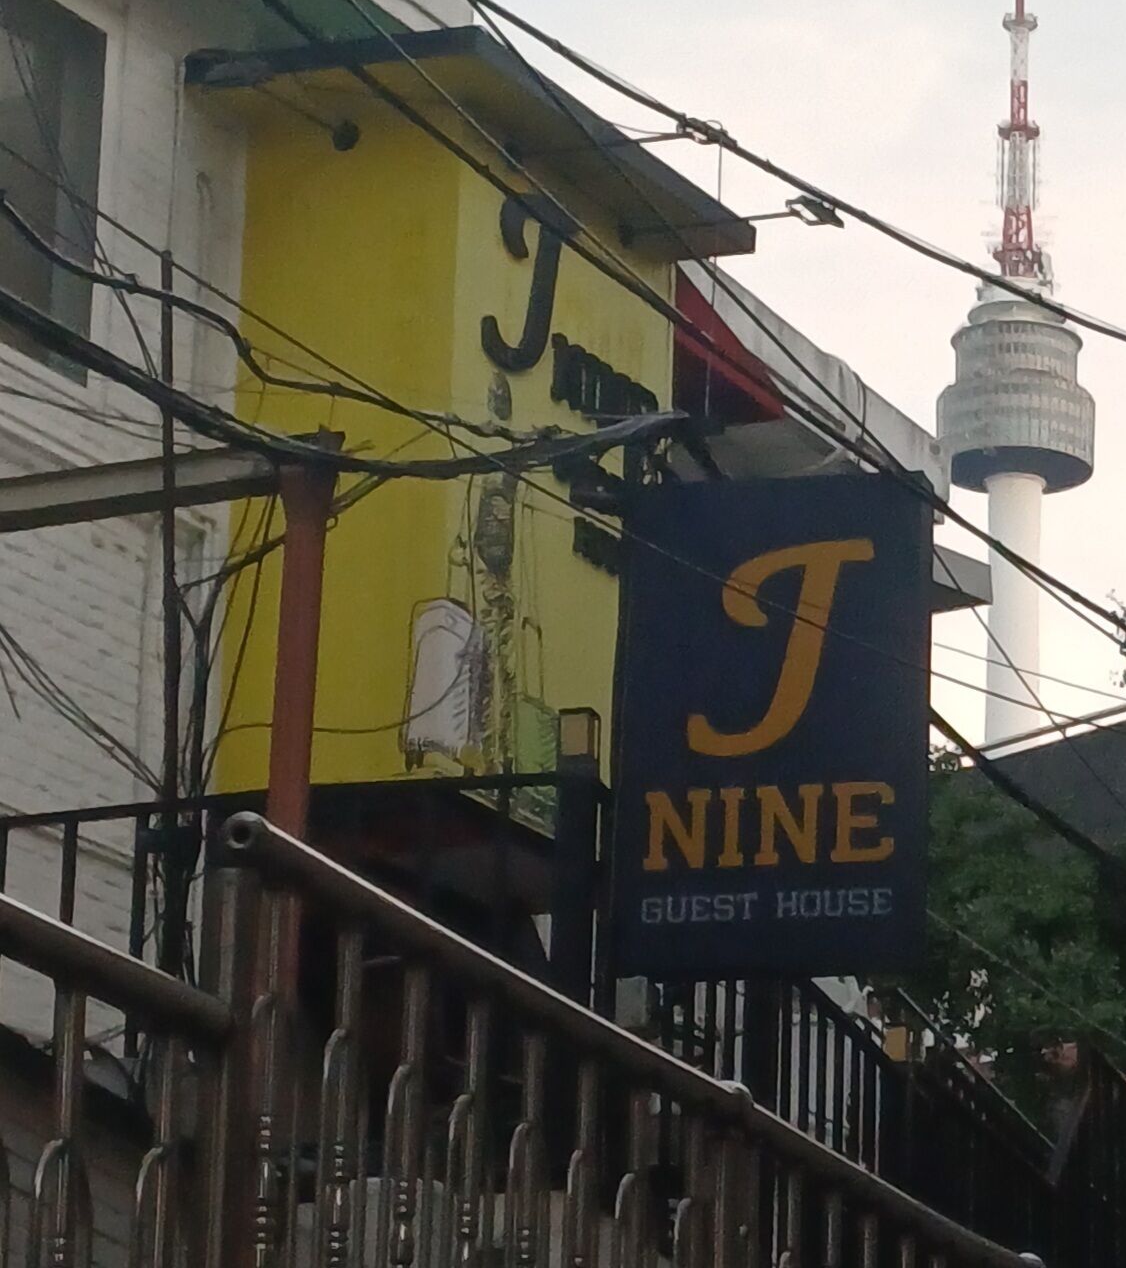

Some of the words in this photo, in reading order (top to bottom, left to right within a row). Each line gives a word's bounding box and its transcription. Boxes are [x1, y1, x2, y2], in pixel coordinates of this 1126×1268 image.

[686, 538, 875, 757] J
[642, 780, 895, 872] NINE
[640, 891, 758, 925] GUEST
[774, 887, 893, 920] HOUSE
